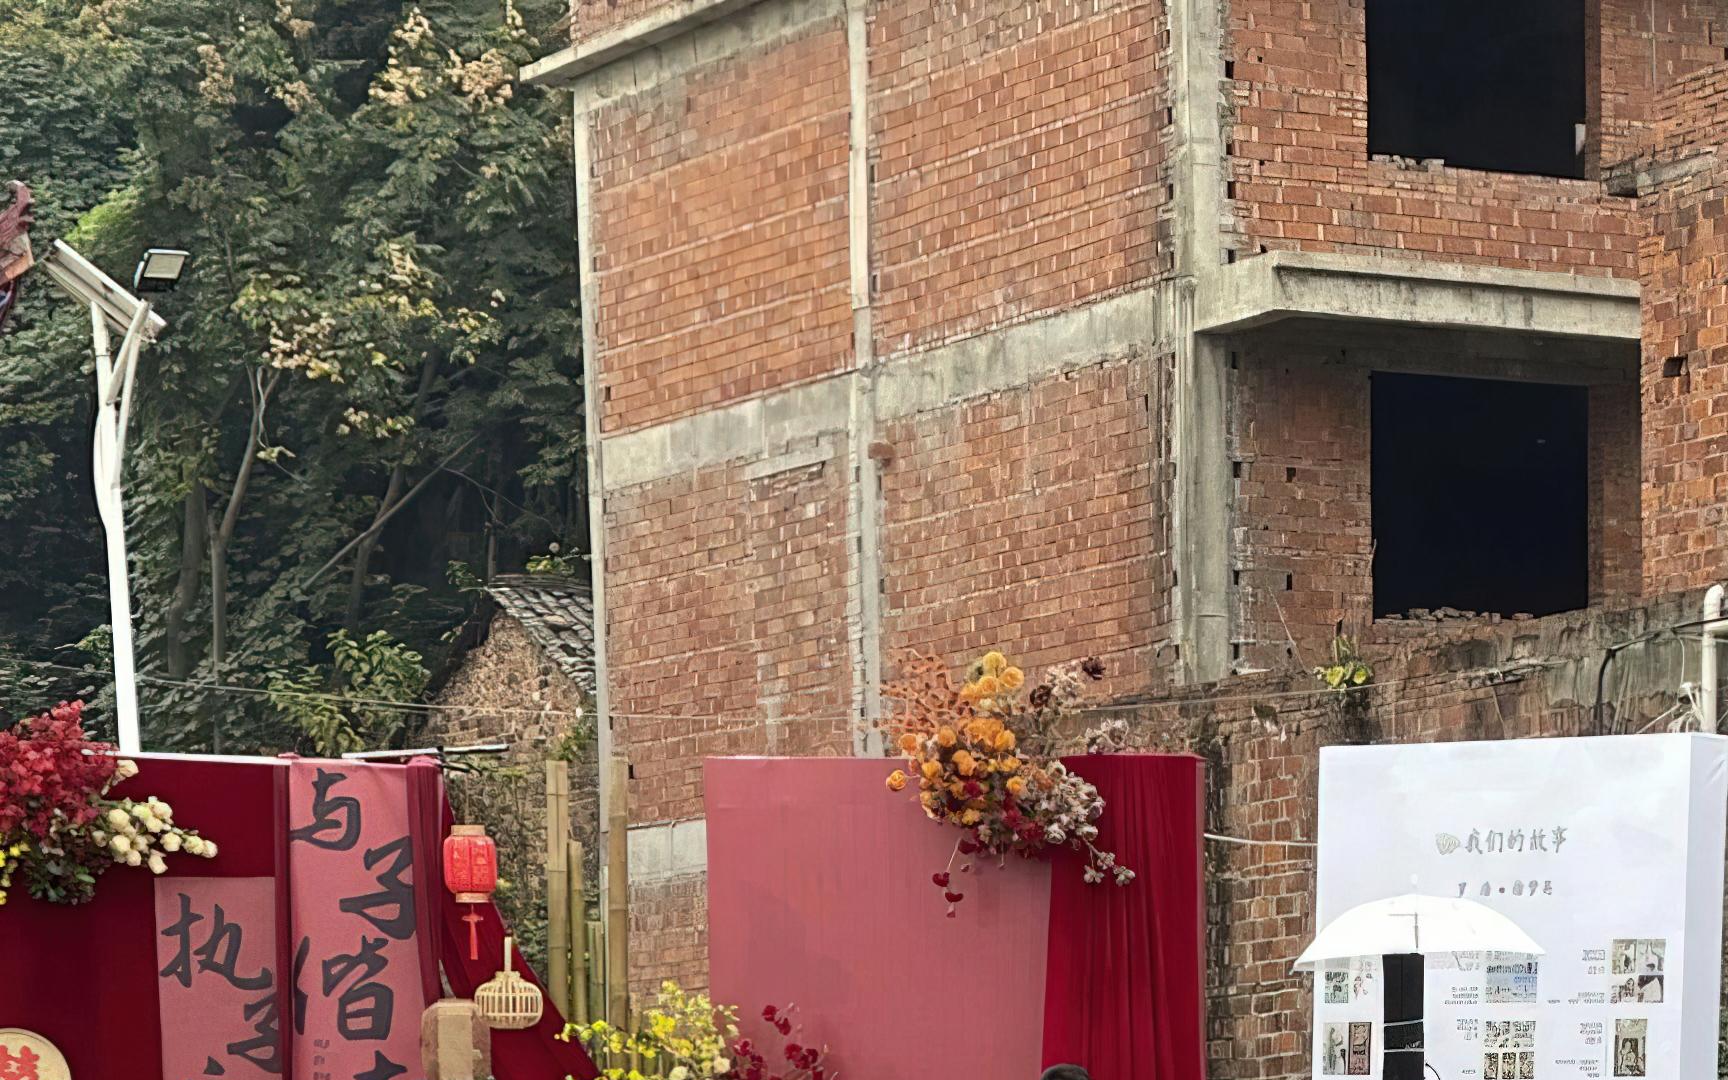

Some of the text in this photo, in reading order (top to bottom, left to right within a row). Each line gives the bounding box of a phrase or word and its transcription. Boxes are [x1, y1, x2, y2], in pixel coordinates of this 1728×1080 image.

[1464, 825, 1569, 855] 我们的故事
